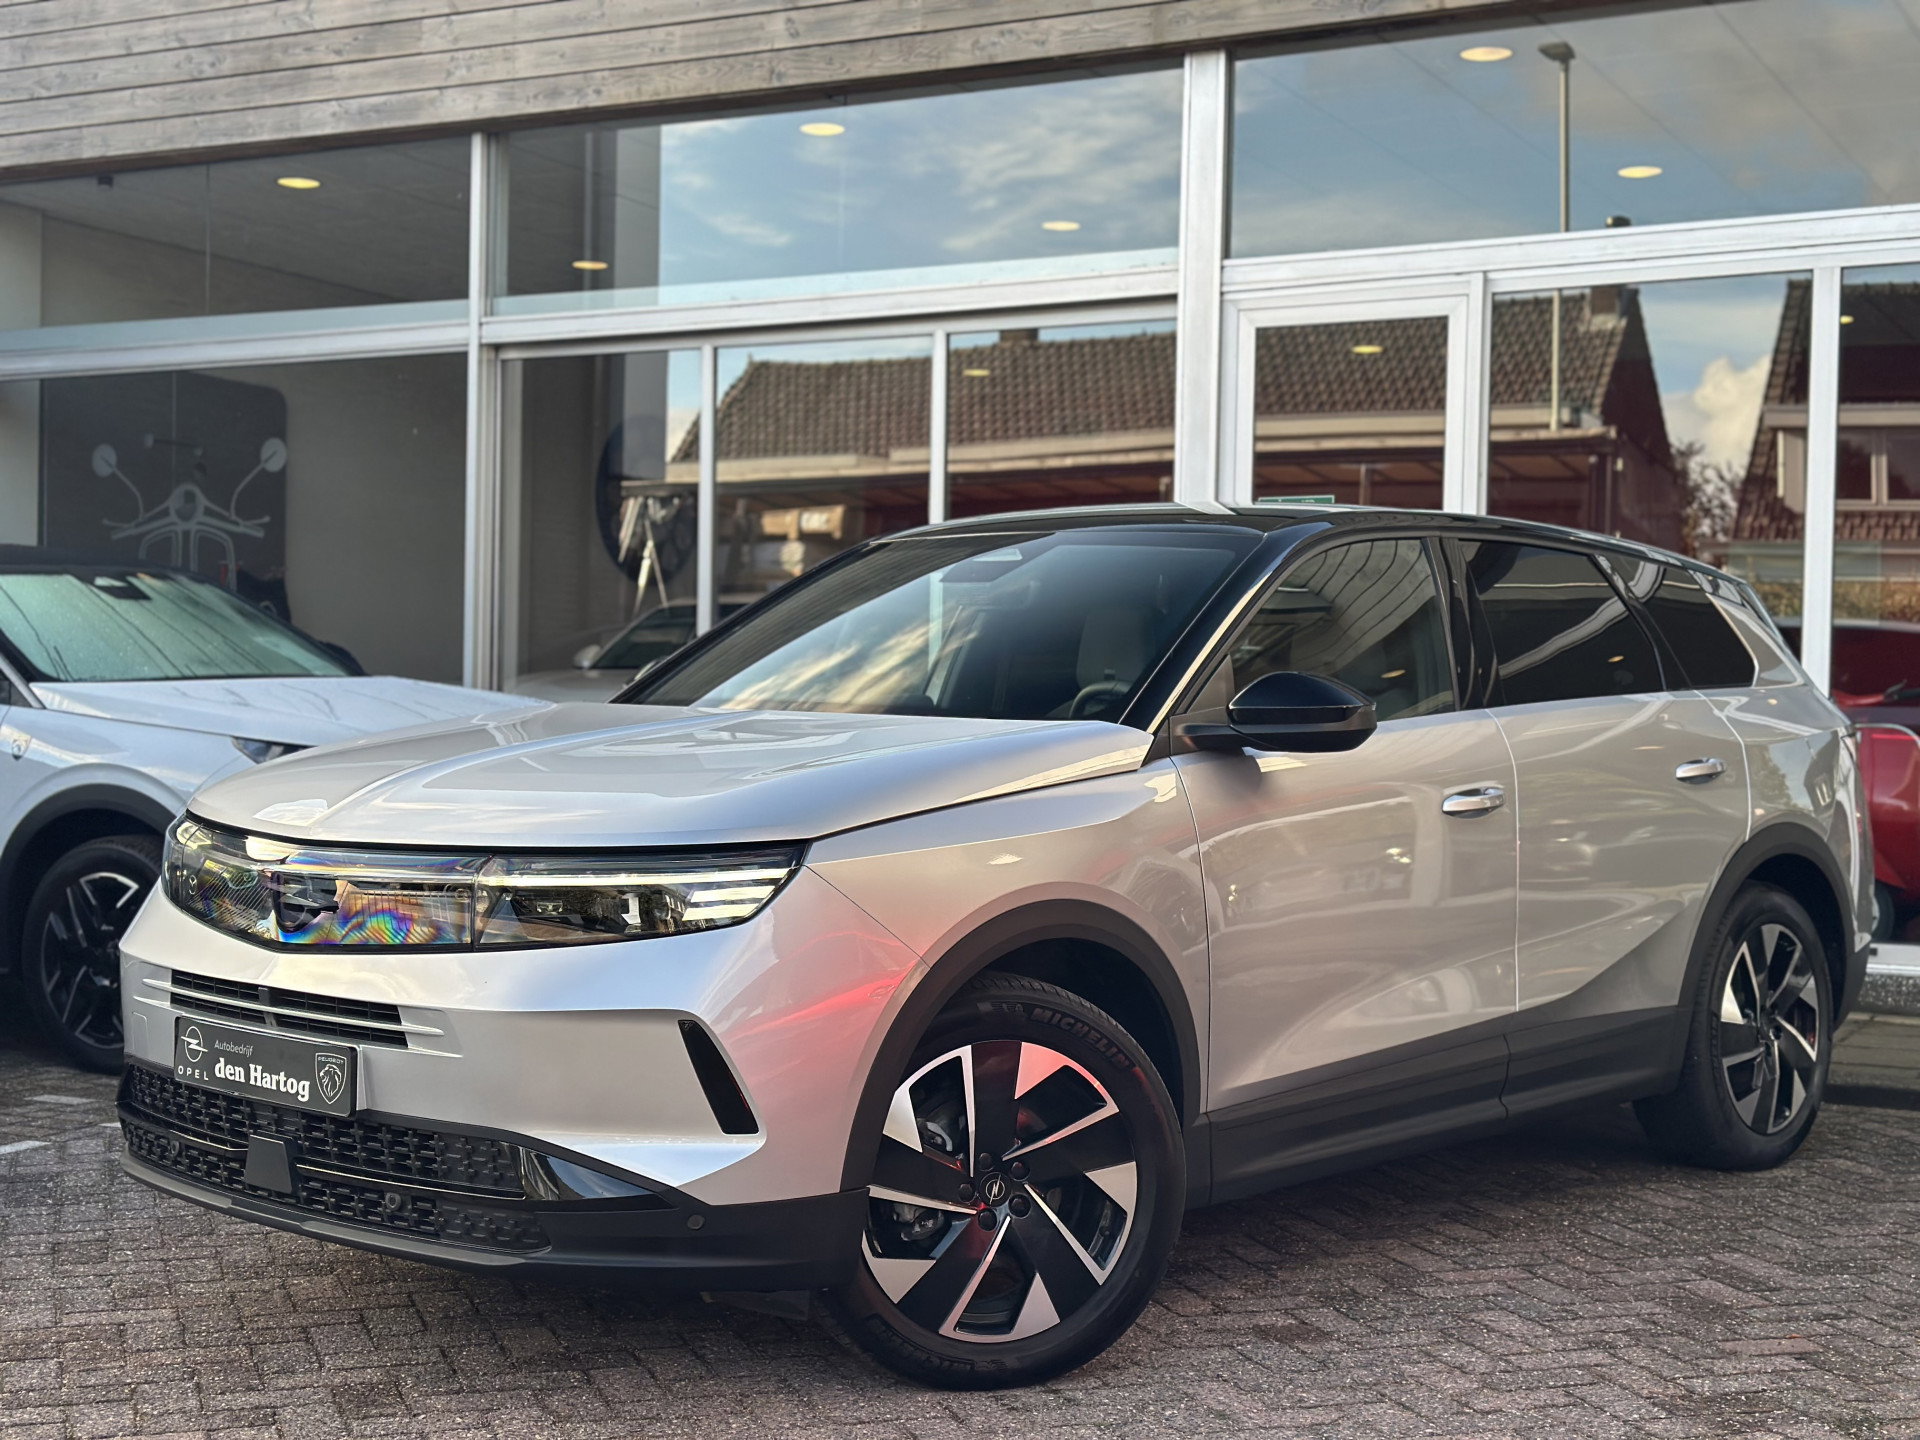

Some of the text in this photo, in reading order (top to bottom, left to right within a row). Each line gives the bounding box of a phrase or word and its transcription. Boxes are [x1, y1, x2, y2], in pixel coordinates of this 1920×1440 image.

[214, 1039, 253, 1058] Autobedrijf
[1028, 1007, 1130, 1069] MICHELIN
[178, 1065, 209, 1081] OPEL
[214, 1057, 310, 1102] den Hartog
